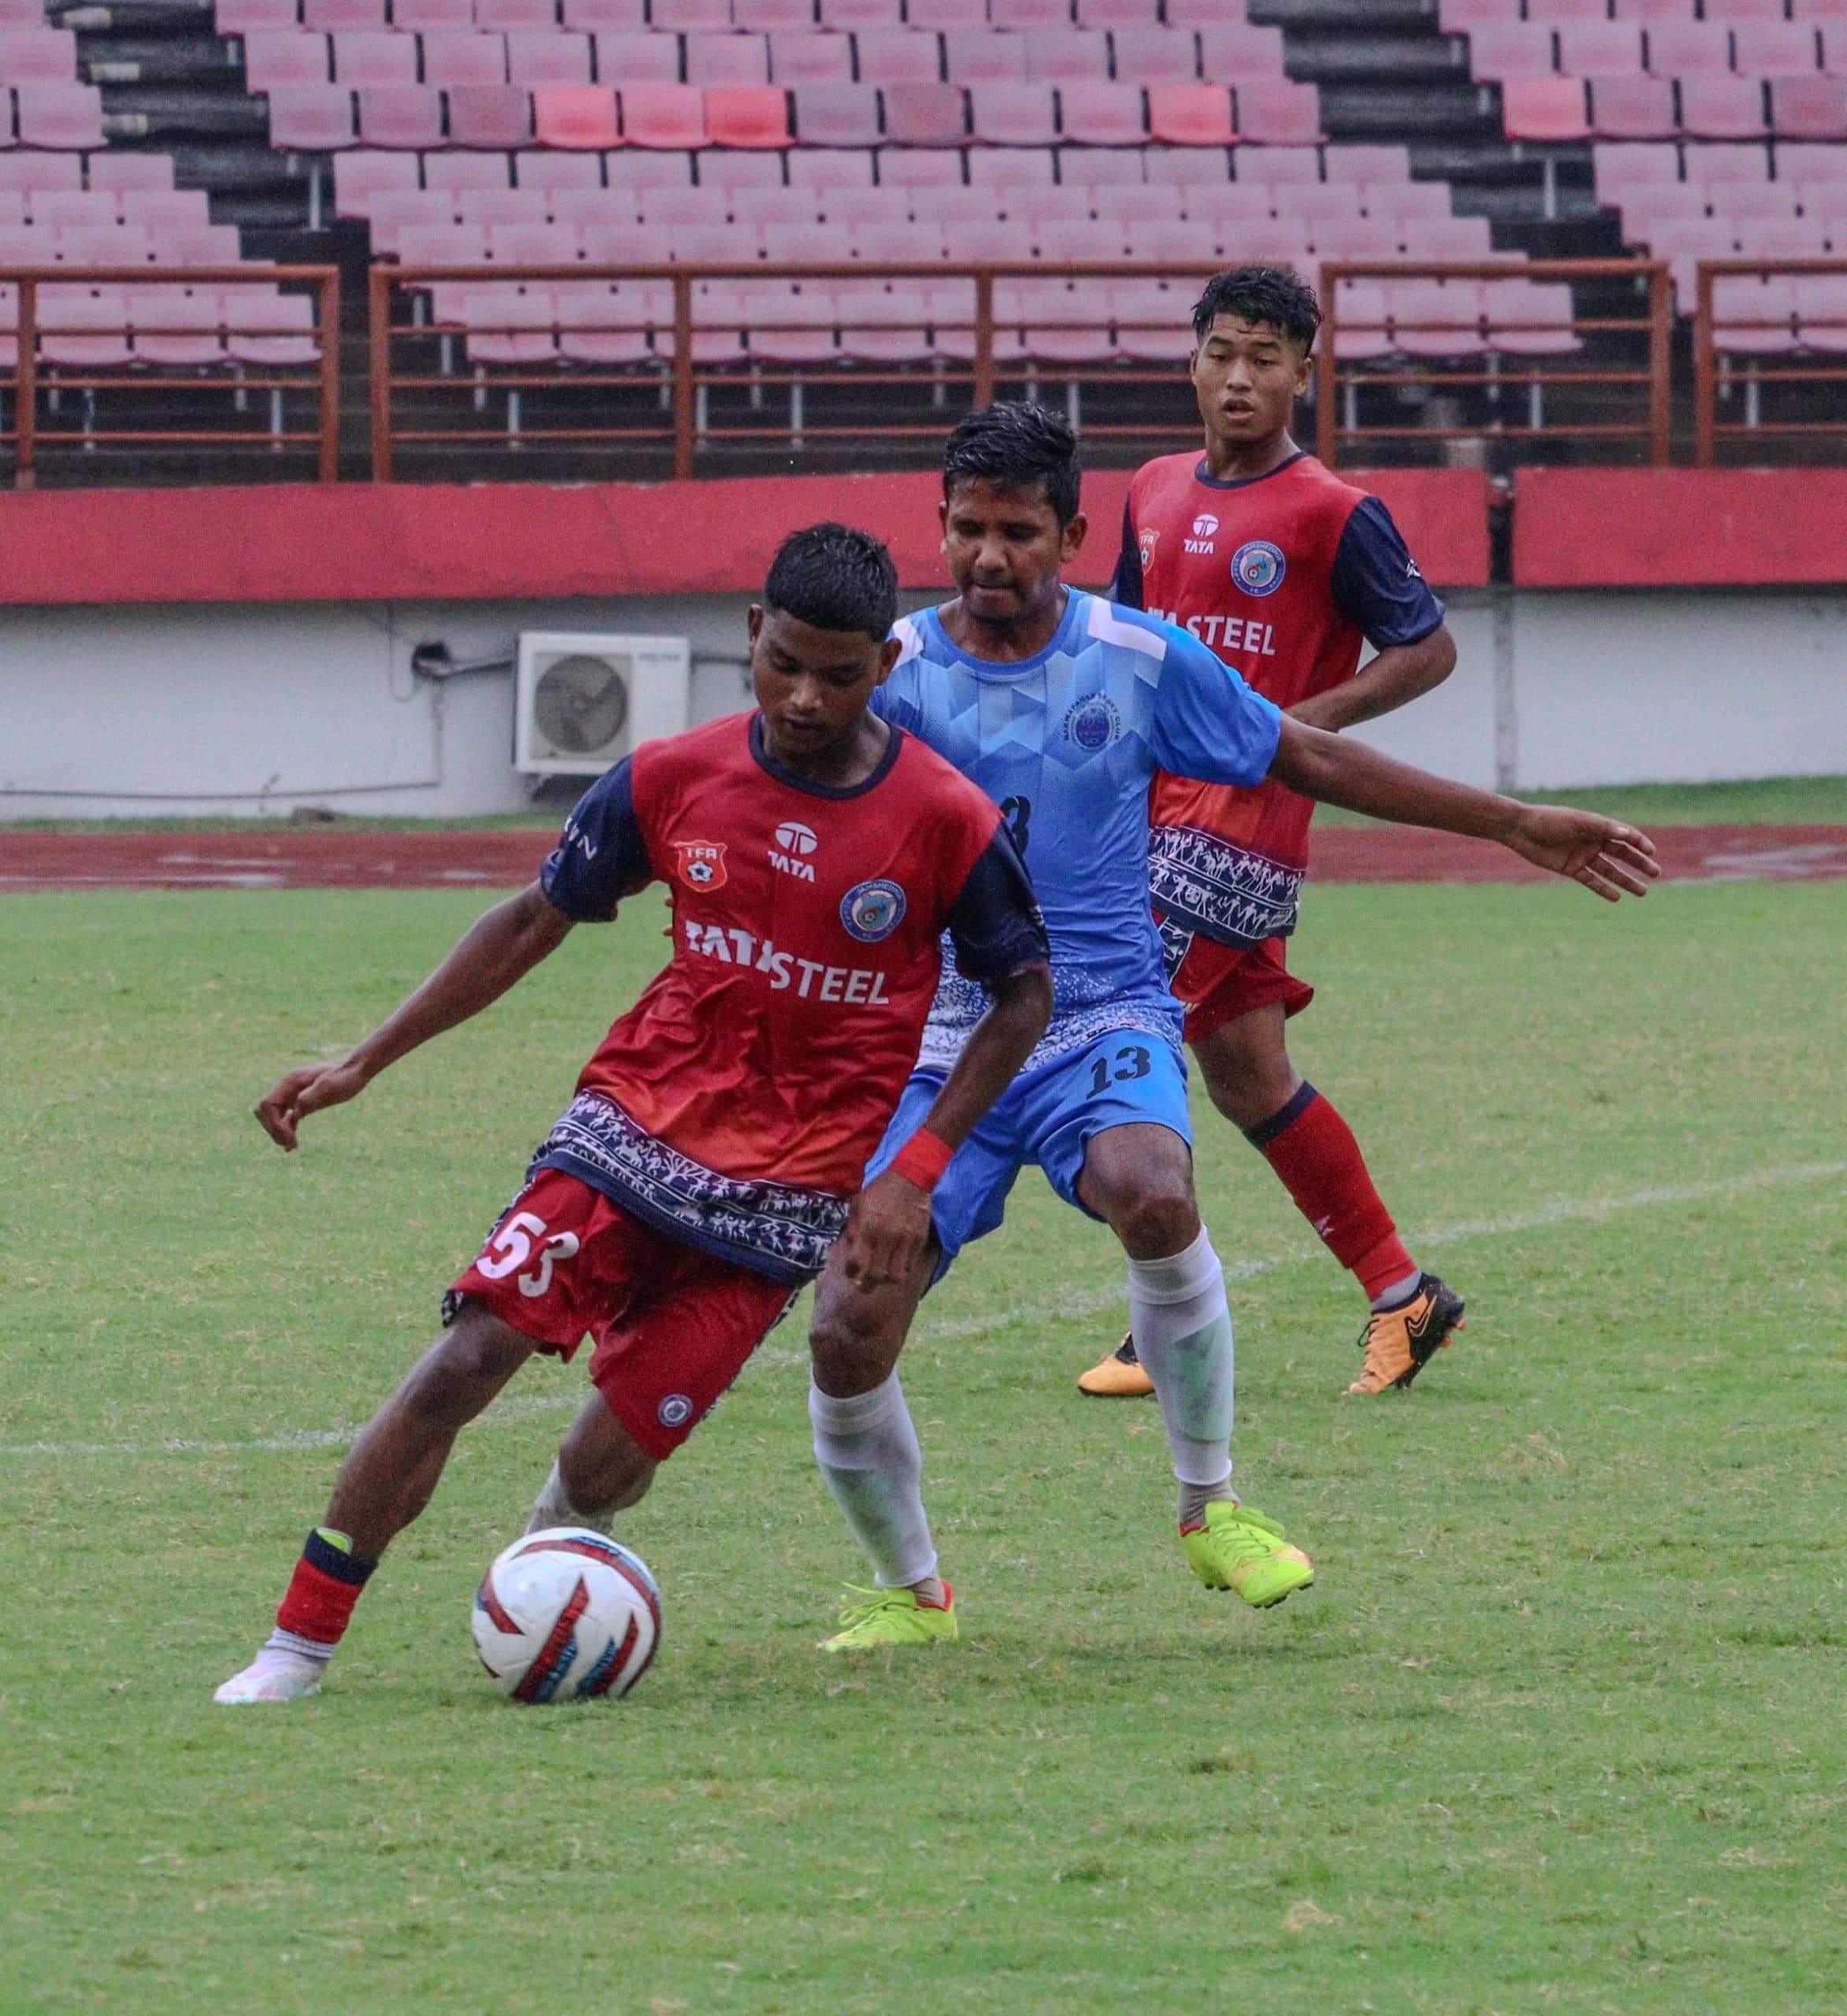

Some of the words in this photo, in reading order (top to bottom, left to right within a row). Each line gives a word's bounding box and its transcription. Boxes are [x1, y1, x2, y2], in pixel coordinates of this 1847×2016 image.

[1183, 539, 1214, 554] TATA
[1186, 615, 1275, 656] STEEL
[768, 850, 816, 883] TATA
[770, 951, 890, 1006] STEEL
[1086, 1046, 1151, 1100] 13
[476, 1211, 580, 1299] 53
